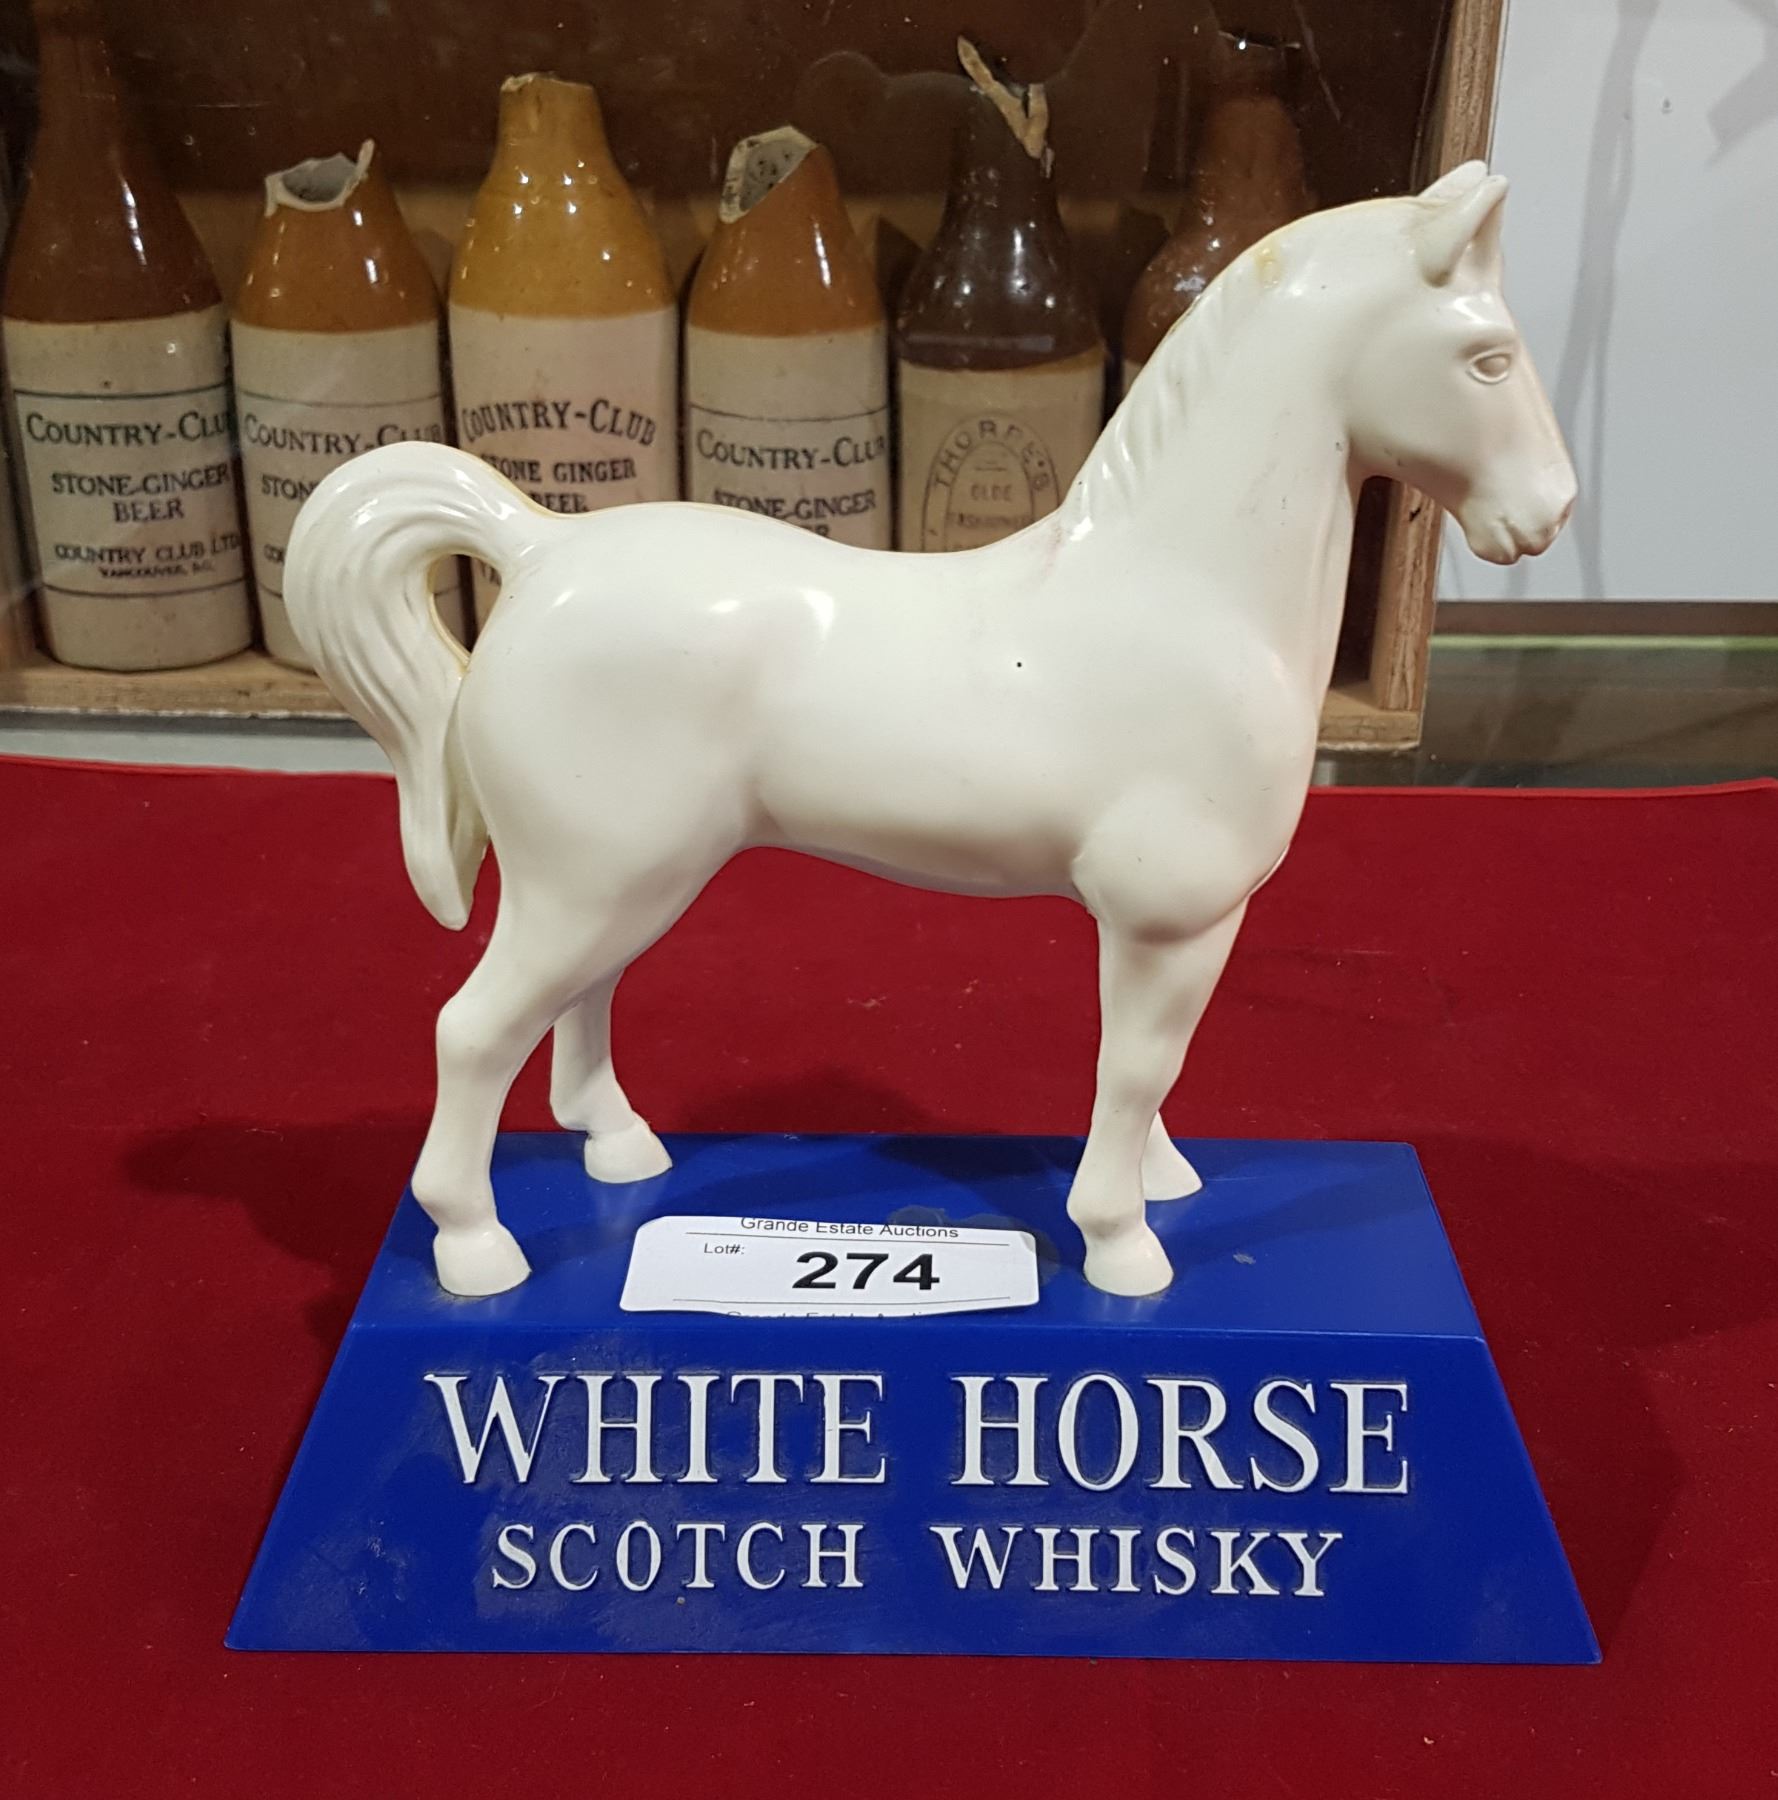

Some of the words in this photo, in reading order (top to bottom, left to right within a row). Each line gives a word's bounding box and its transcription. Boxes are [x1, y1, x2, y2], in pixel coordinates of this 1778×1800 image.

[26, 409, 230, 447] COUNTRY-CLU
[460, 397, 657, 446] COUNTRY-CLUB
[552, 457, 638, 484] GINGER
[261, 474, 320, 502] STON
[113, 497, 186, 523] BEER
[54, 543, 146, 564] COUNTRY
[155, 540, 206, 562] CLUB
[740, 1216, 809, 1233] Grande
[816, 1222, 874, 1236] Estate
[879, 1224, 960, 1239] Auctions
[703, 1242, 745, 1255] Lot#:
[791, 1250, 941, 1291] 274
[422, 1371, 887, 1485] WHITE
[950, 1372, 1409, 1496] HORSE
[491, 1520, 866, 1592] SCOTCH
[928, 1525, 1344, 1597] WHISKY
